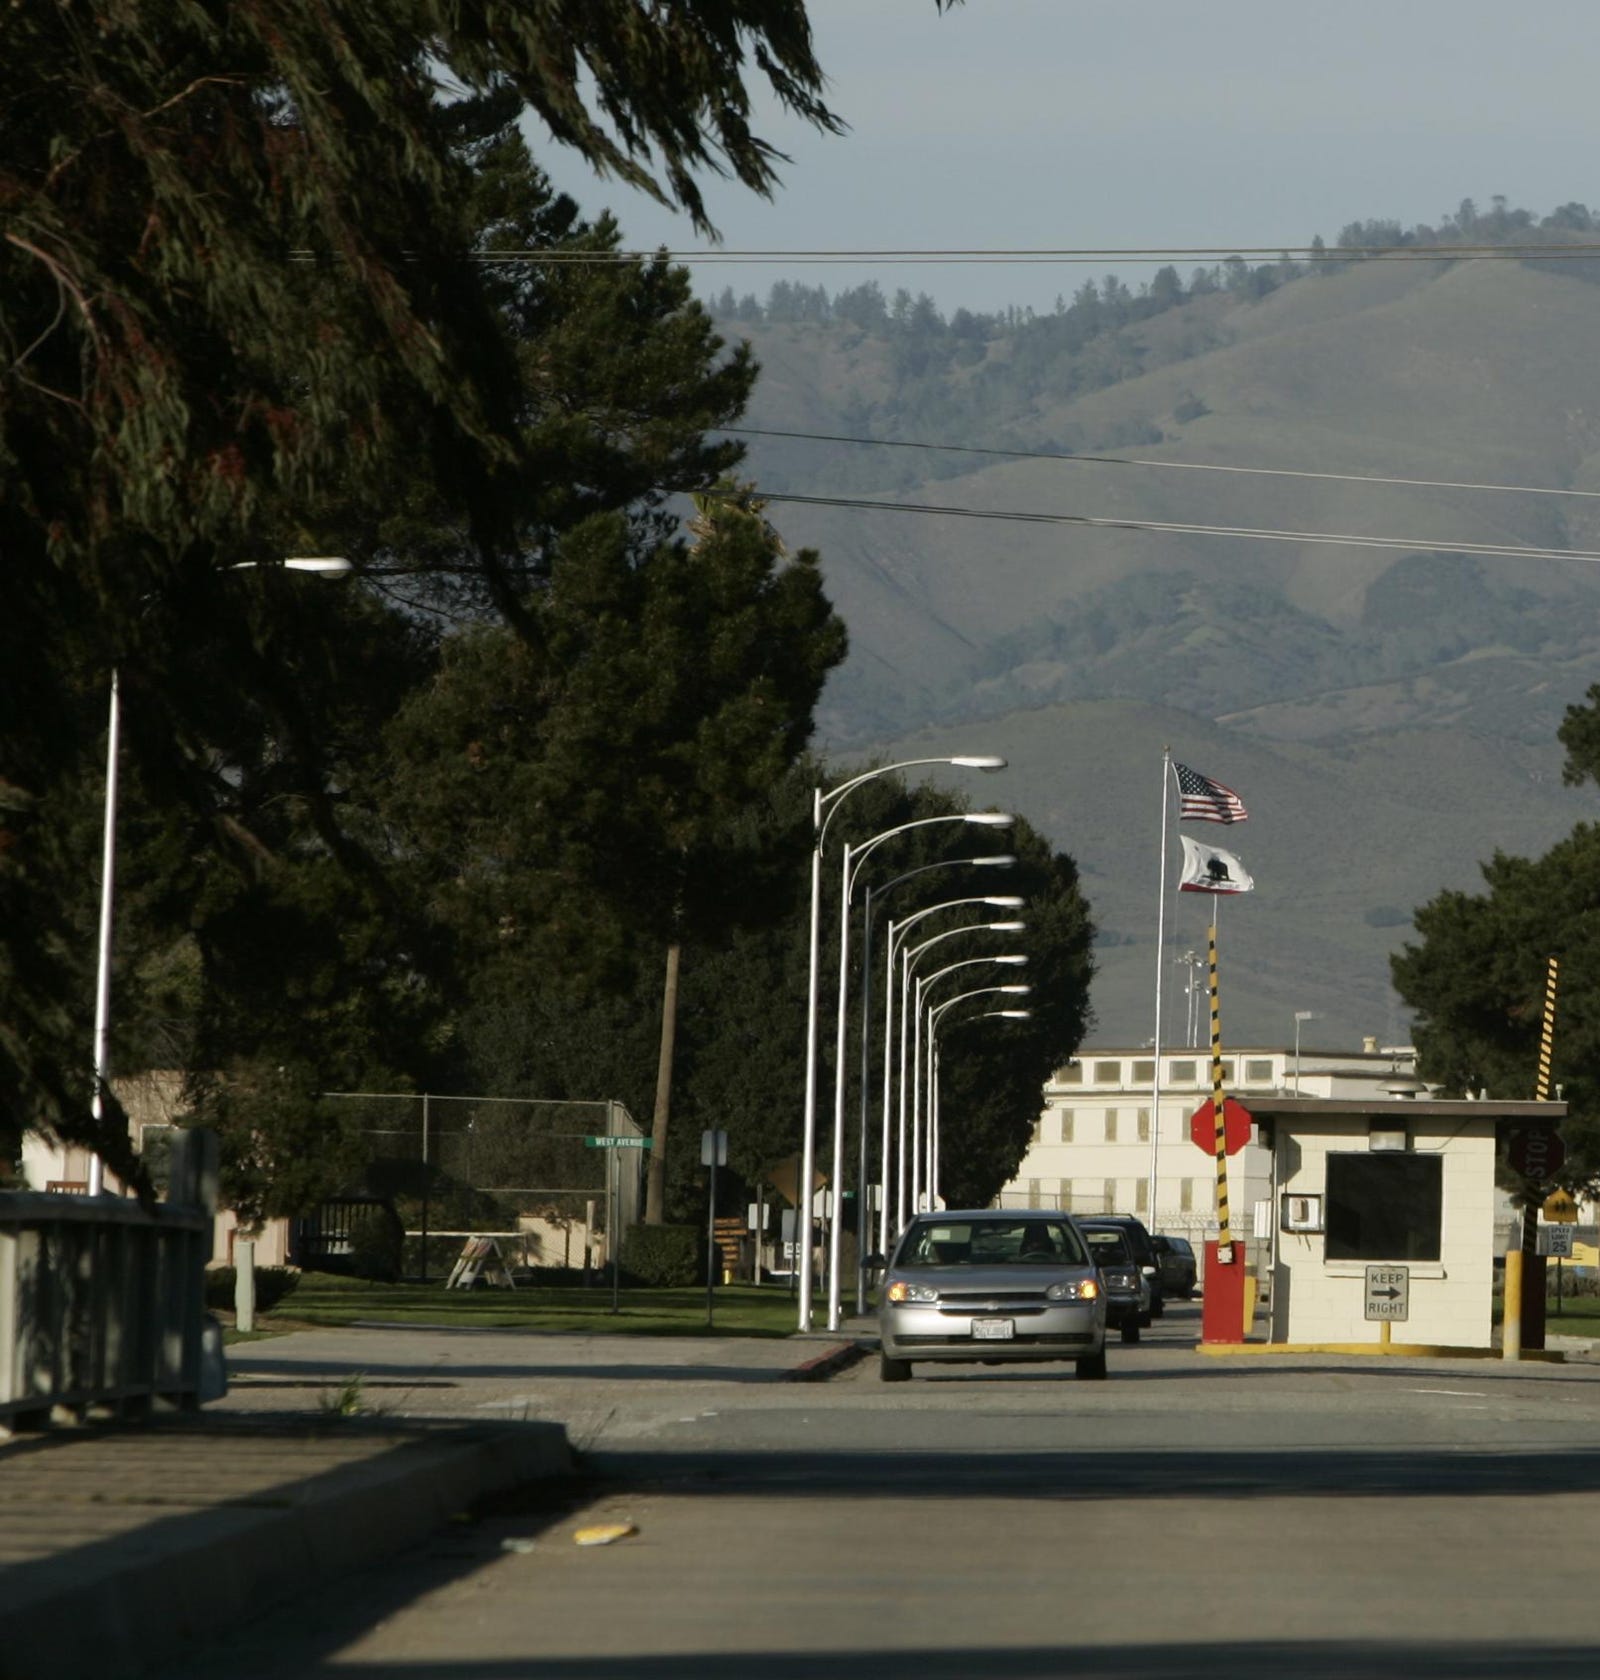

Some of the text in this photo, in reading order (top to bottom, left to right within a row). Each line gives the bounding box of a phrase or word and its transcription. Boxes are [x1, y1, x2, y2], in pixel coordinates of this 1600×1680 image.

[595, 1137, 614, 1147] WEST
[1525, 1130, 1549, 1178] STOP
[1552, 1241, 1568, 1253] 25
[1371, 1273, 1404, 1284] KEEP
[1368, 1303, 1405, 1314] RIGHT
